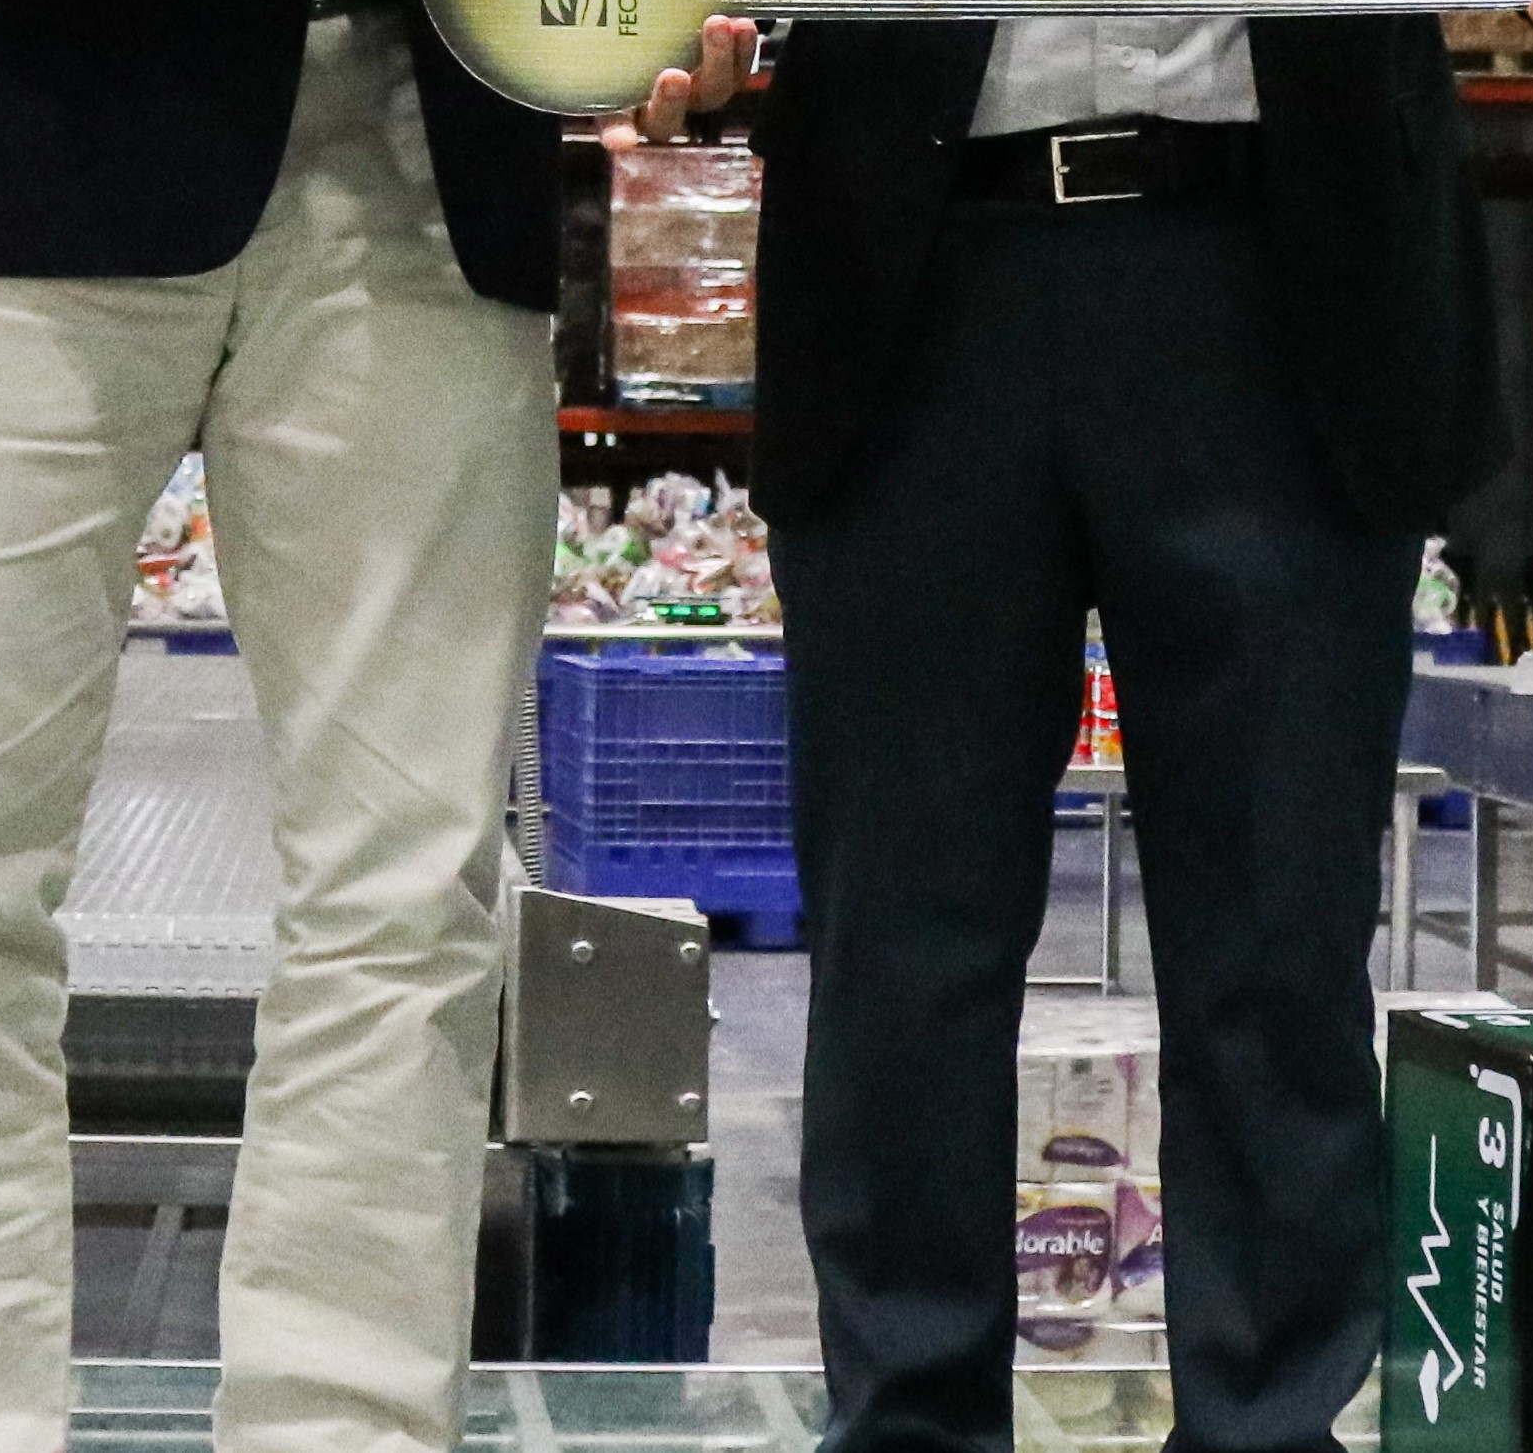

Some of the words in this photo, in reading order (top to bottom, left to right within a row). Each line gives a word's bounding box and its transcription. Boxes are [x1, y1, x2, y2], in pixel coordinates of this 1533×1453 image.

[1478, 1116, 1507, 1170] 3
[1490, 1201, 1506, 1304] SALUD
[1474, 1223, 1490, 1390] BIENESTAR
